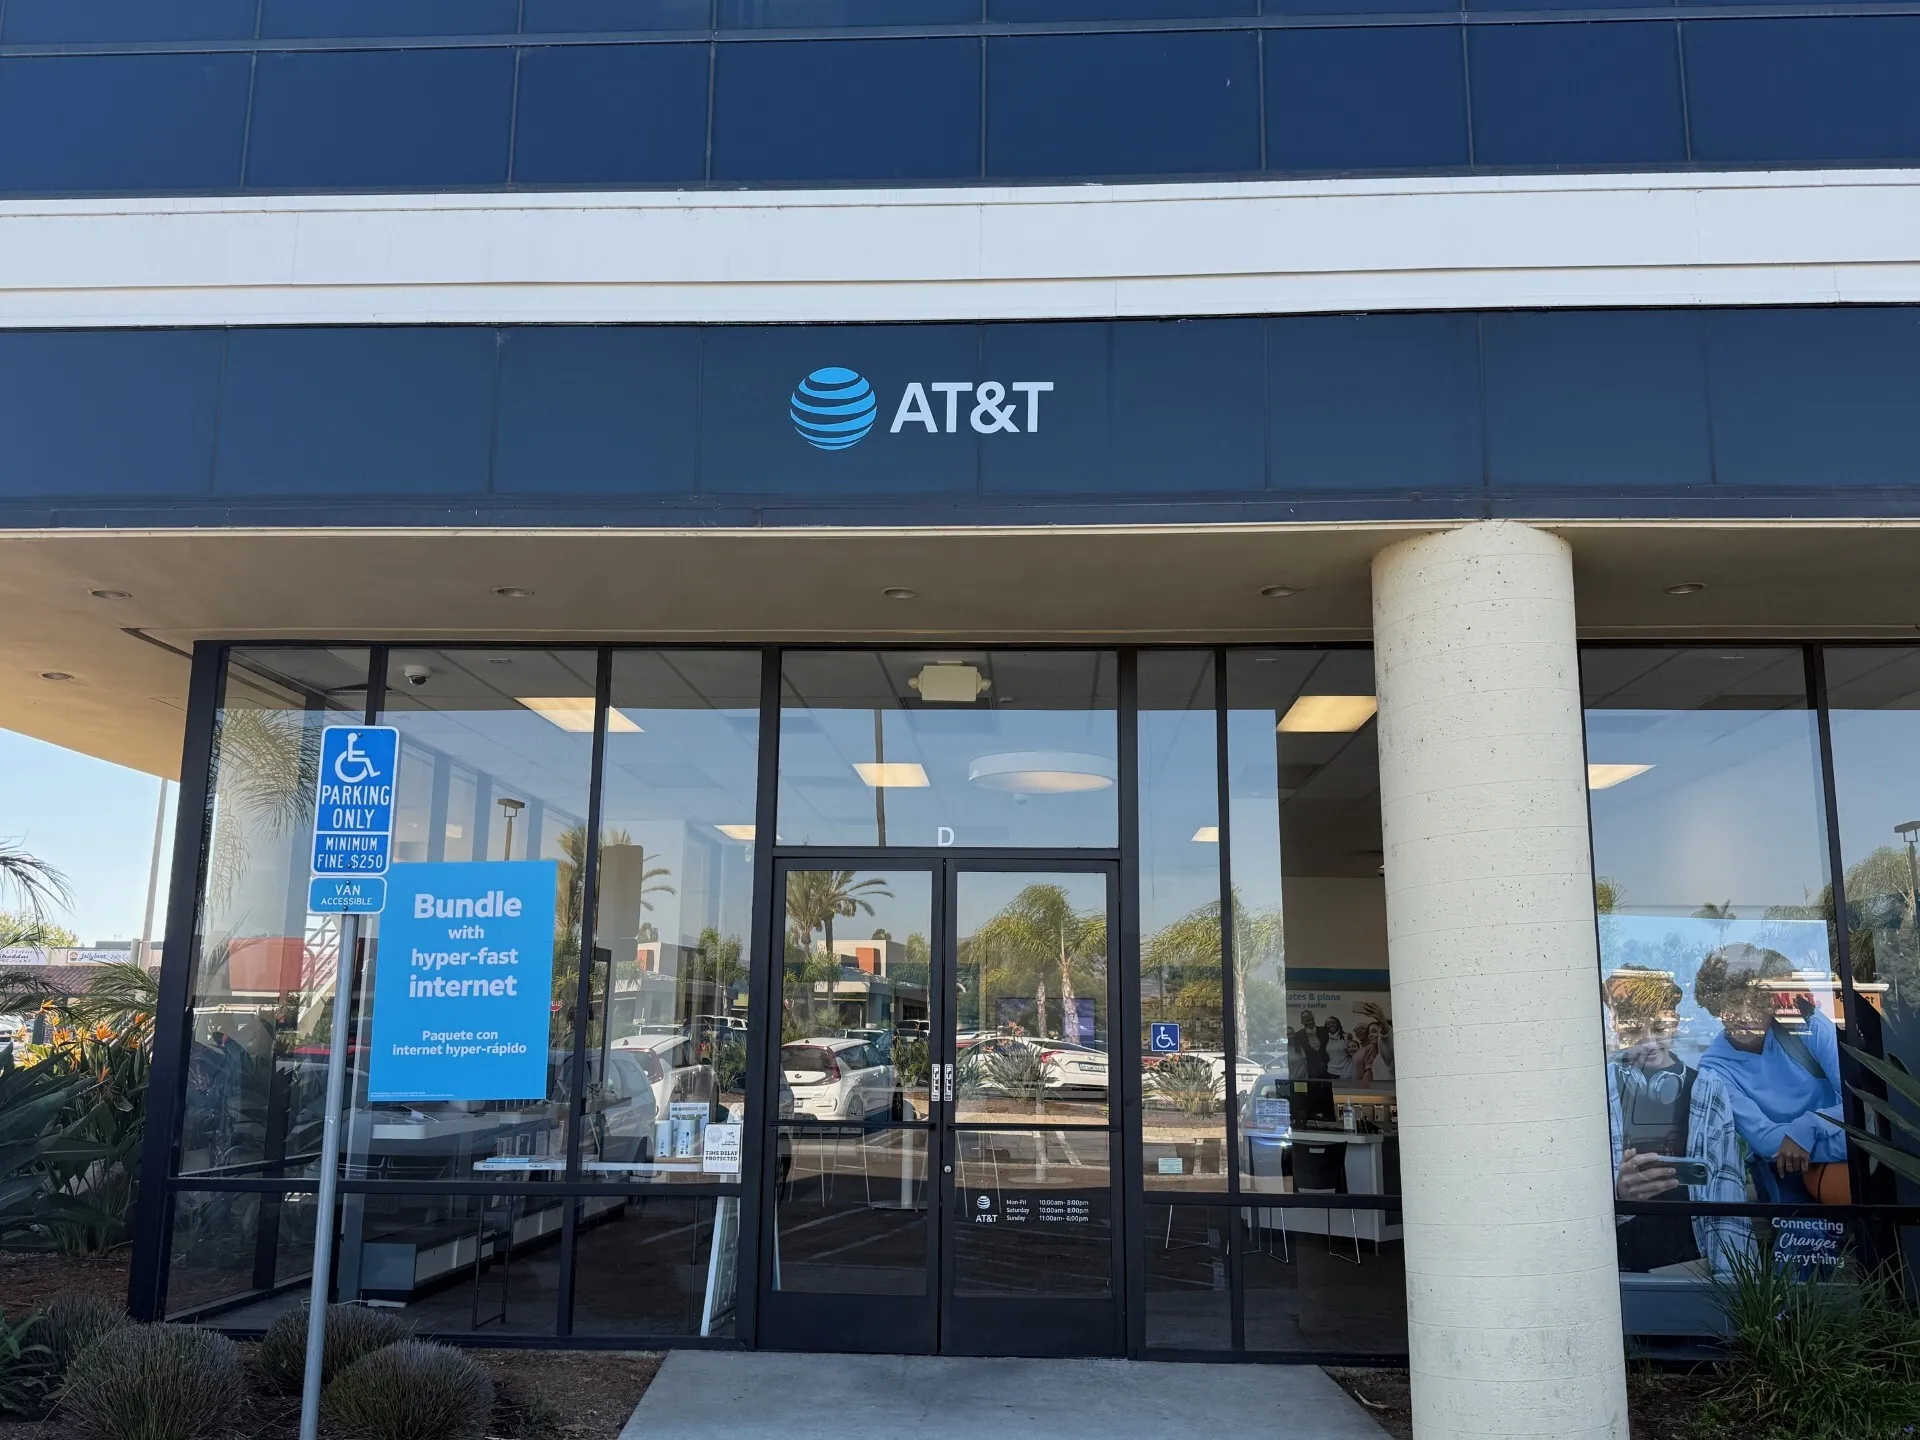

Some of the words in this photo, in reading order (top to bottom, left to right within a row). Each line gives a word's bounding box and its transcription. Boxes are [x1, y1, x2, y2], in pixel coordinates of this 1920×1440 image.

[890, 381, 1054, 434] AT&T
[321, 785, 390, 806] PARKING
[333, 808, 375, 829] ONLY
[325, 836, 378, 851] MINIMUM
[937, 826, 954, 847] D
[317, 854, 344, 869] FINE
[351, 854, 383, 869] $250
[335, 884, 361, 896] VAN
[321, 897, 373, 906] ACCESSIBLE
[414, 890, 522, 919] Bundle
[448, 925, 485, 940] with
[411, 948, 519, 971] hyper-fast
[409, 974, 518, 998] internet
[1286, 993, 1307, 1001] ates
[1309, 993, 1315, 1001] &
[1317, 993, 1341, 1002] plans
[422, 1030, 473, 1043] Paquete
[476, 1031, 499, 1041] con
[392, 1044, 443, 1056] internet
[445, 1042, 527, 1057] hyper-rápido
[976, 1214, 998, 1223] AT&T
[1771, 1217, 1844, 1234] Connecting
[1779, 1232, 1837, 1251] Changes
